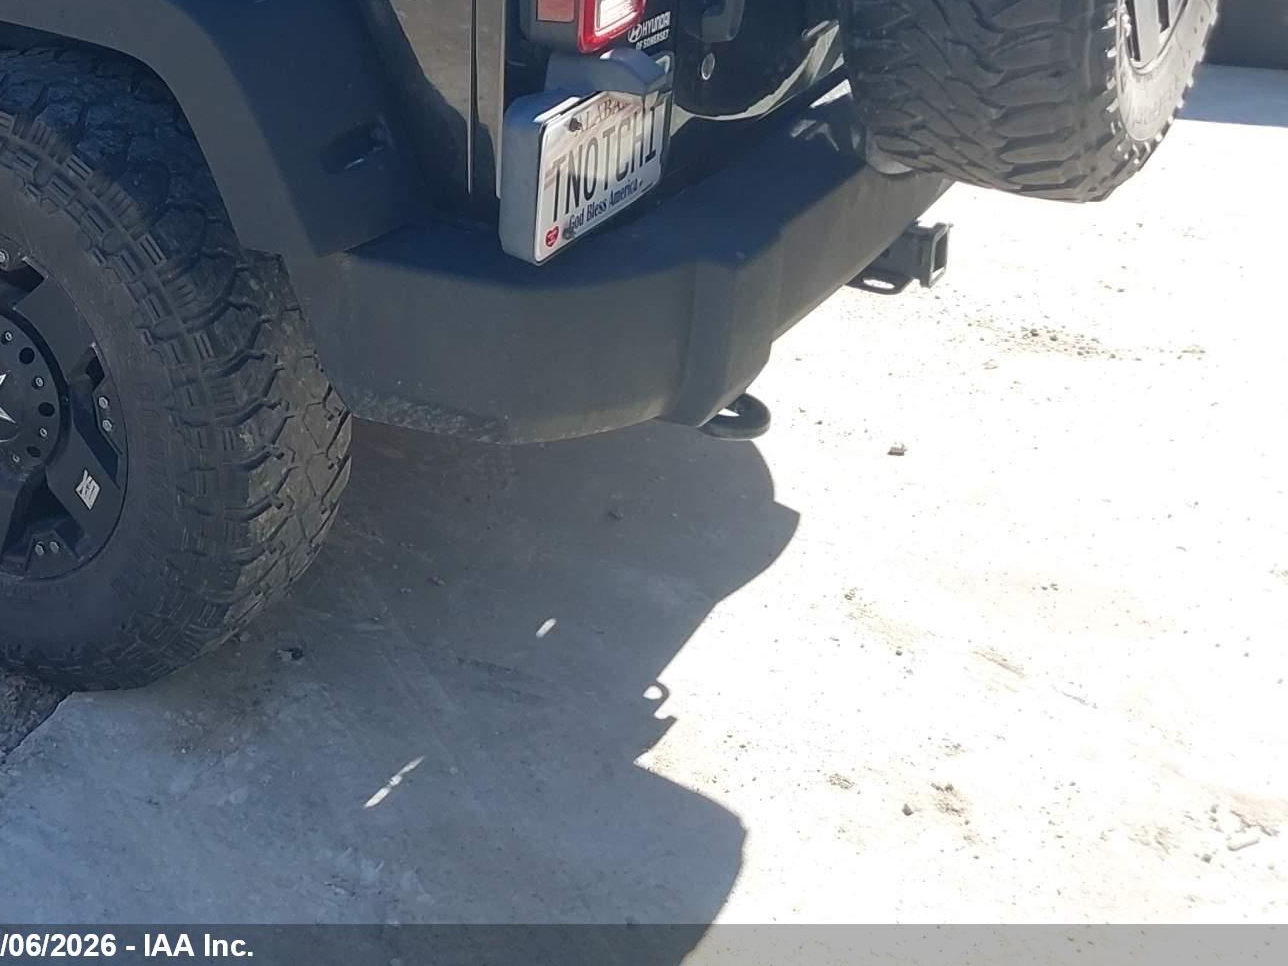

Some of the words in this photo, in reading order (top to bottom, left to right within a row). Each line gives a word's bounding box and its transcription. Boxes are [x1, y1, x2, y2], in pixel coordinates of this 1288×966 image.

[642, 10, 671, 37] HYUNDAI
[567, 209, 584, 232] God
[586, 197, 609, 223] Bless
[609, 177, 638, 209] America
